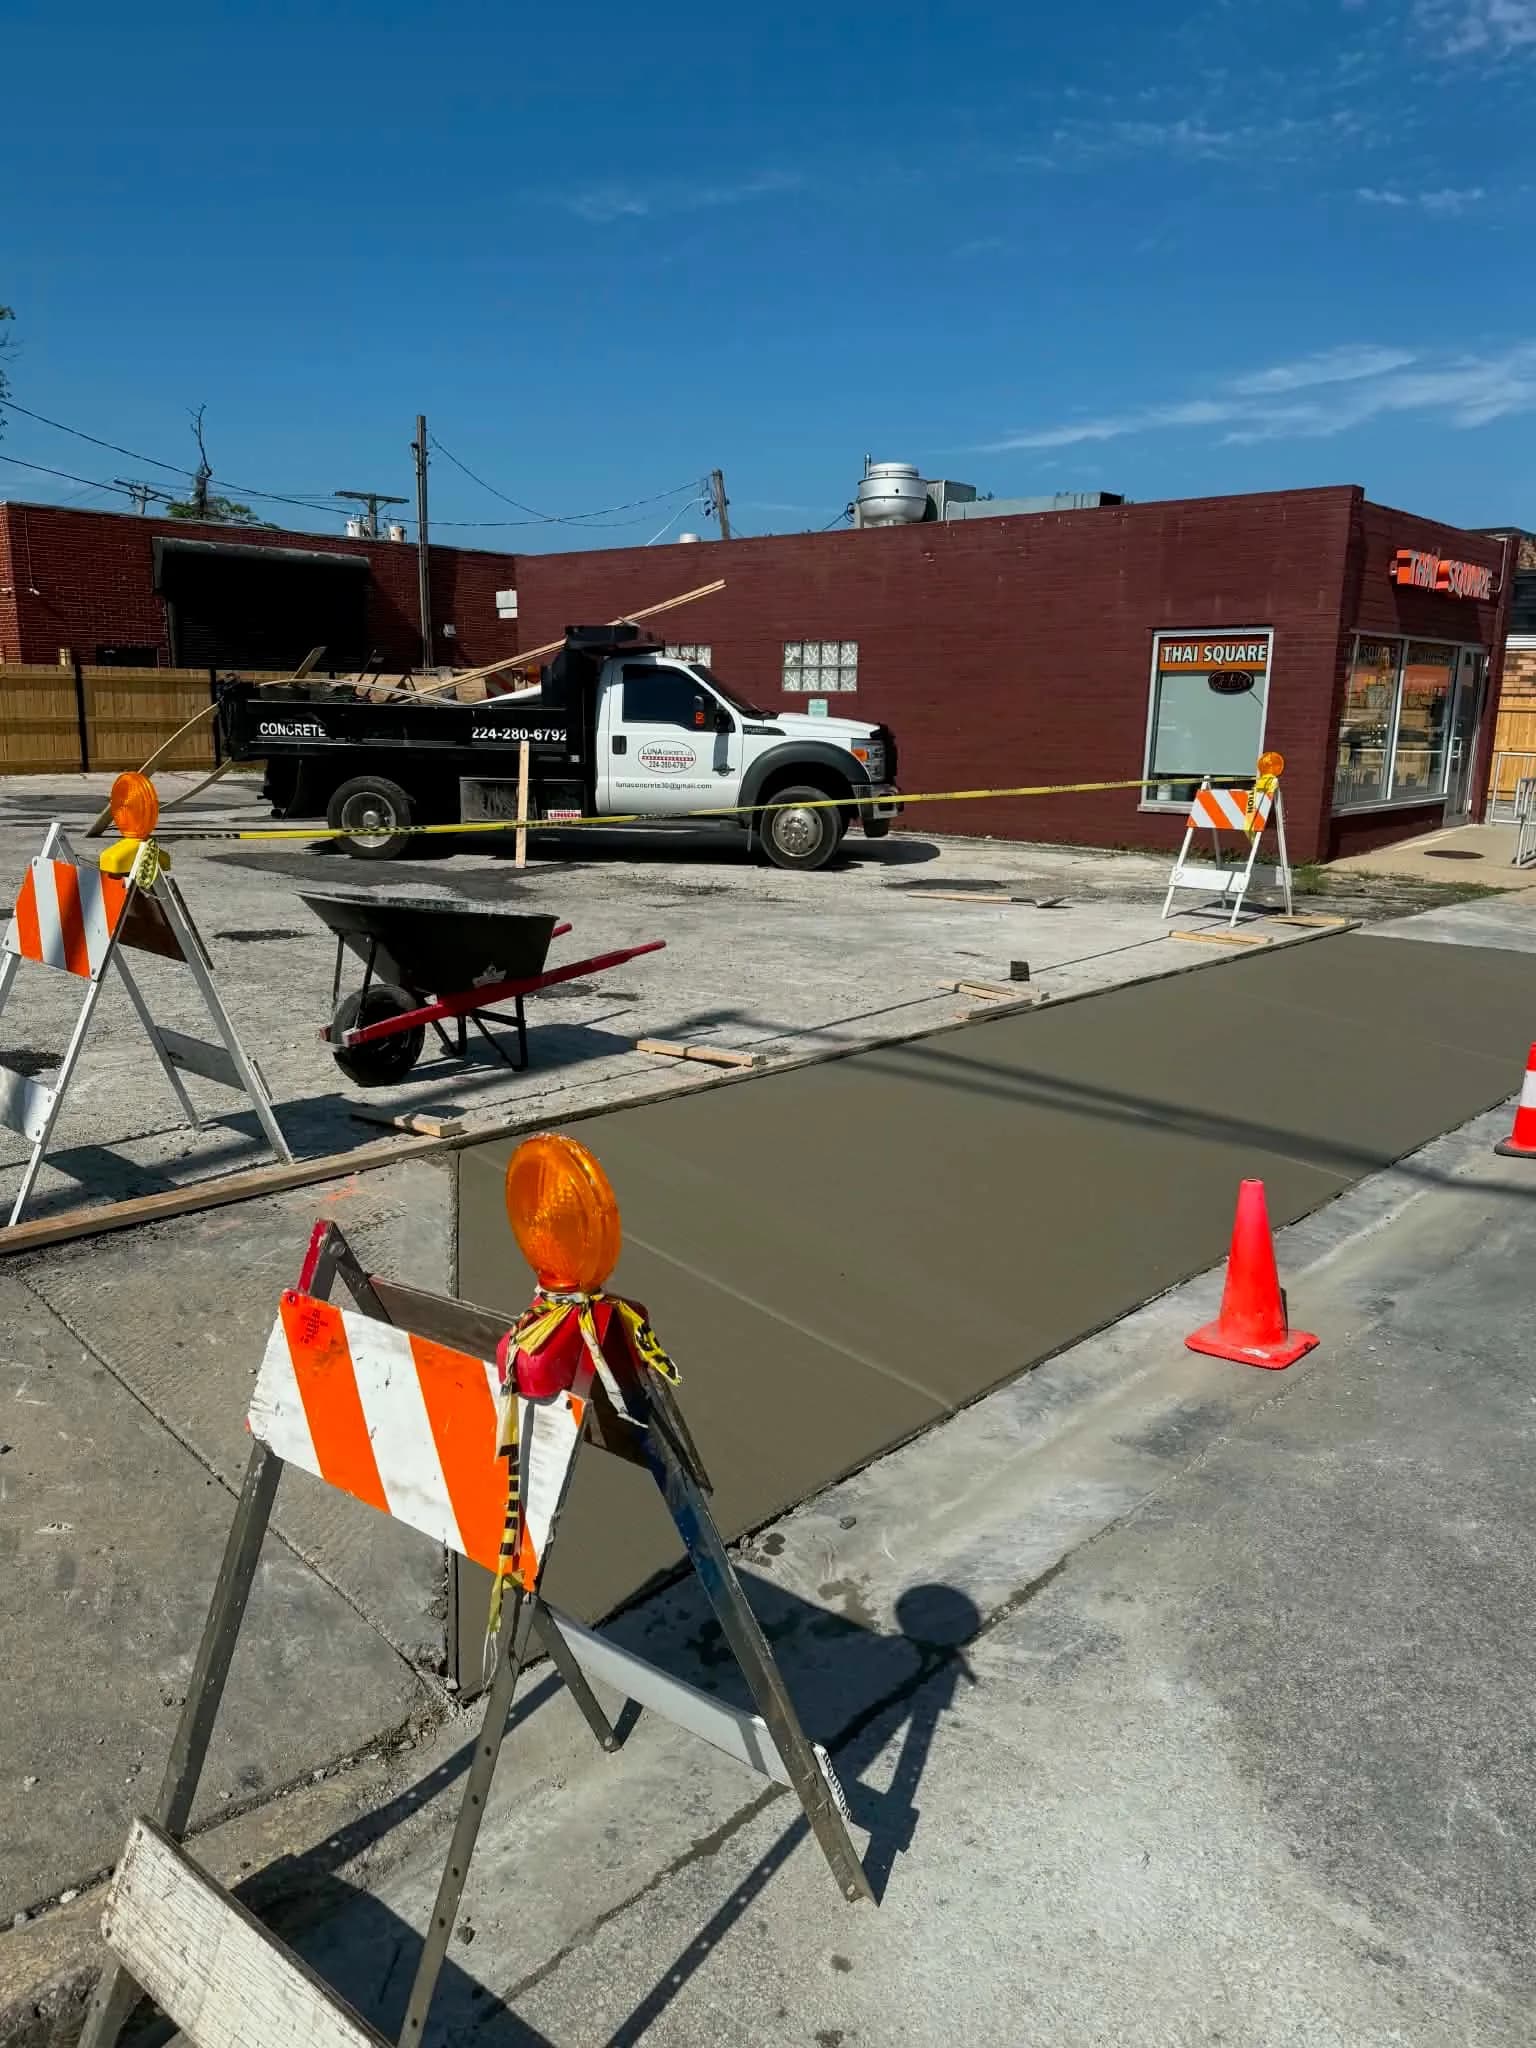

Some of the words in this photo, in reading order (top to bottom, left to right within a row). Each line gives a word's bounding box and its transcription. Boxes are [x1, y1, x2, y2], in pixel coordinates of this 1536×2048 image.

[1447, 560, 1493, 600] SQUARE
[1163, 645, 1198, 664] THAI
[1203, 644, 1268, 665] SQUARE
[259, 722, 327, 737] CONCRETE
[471, 726, 568, 741] 224-280-6792
[642, 747, 663, 756] LUNA
